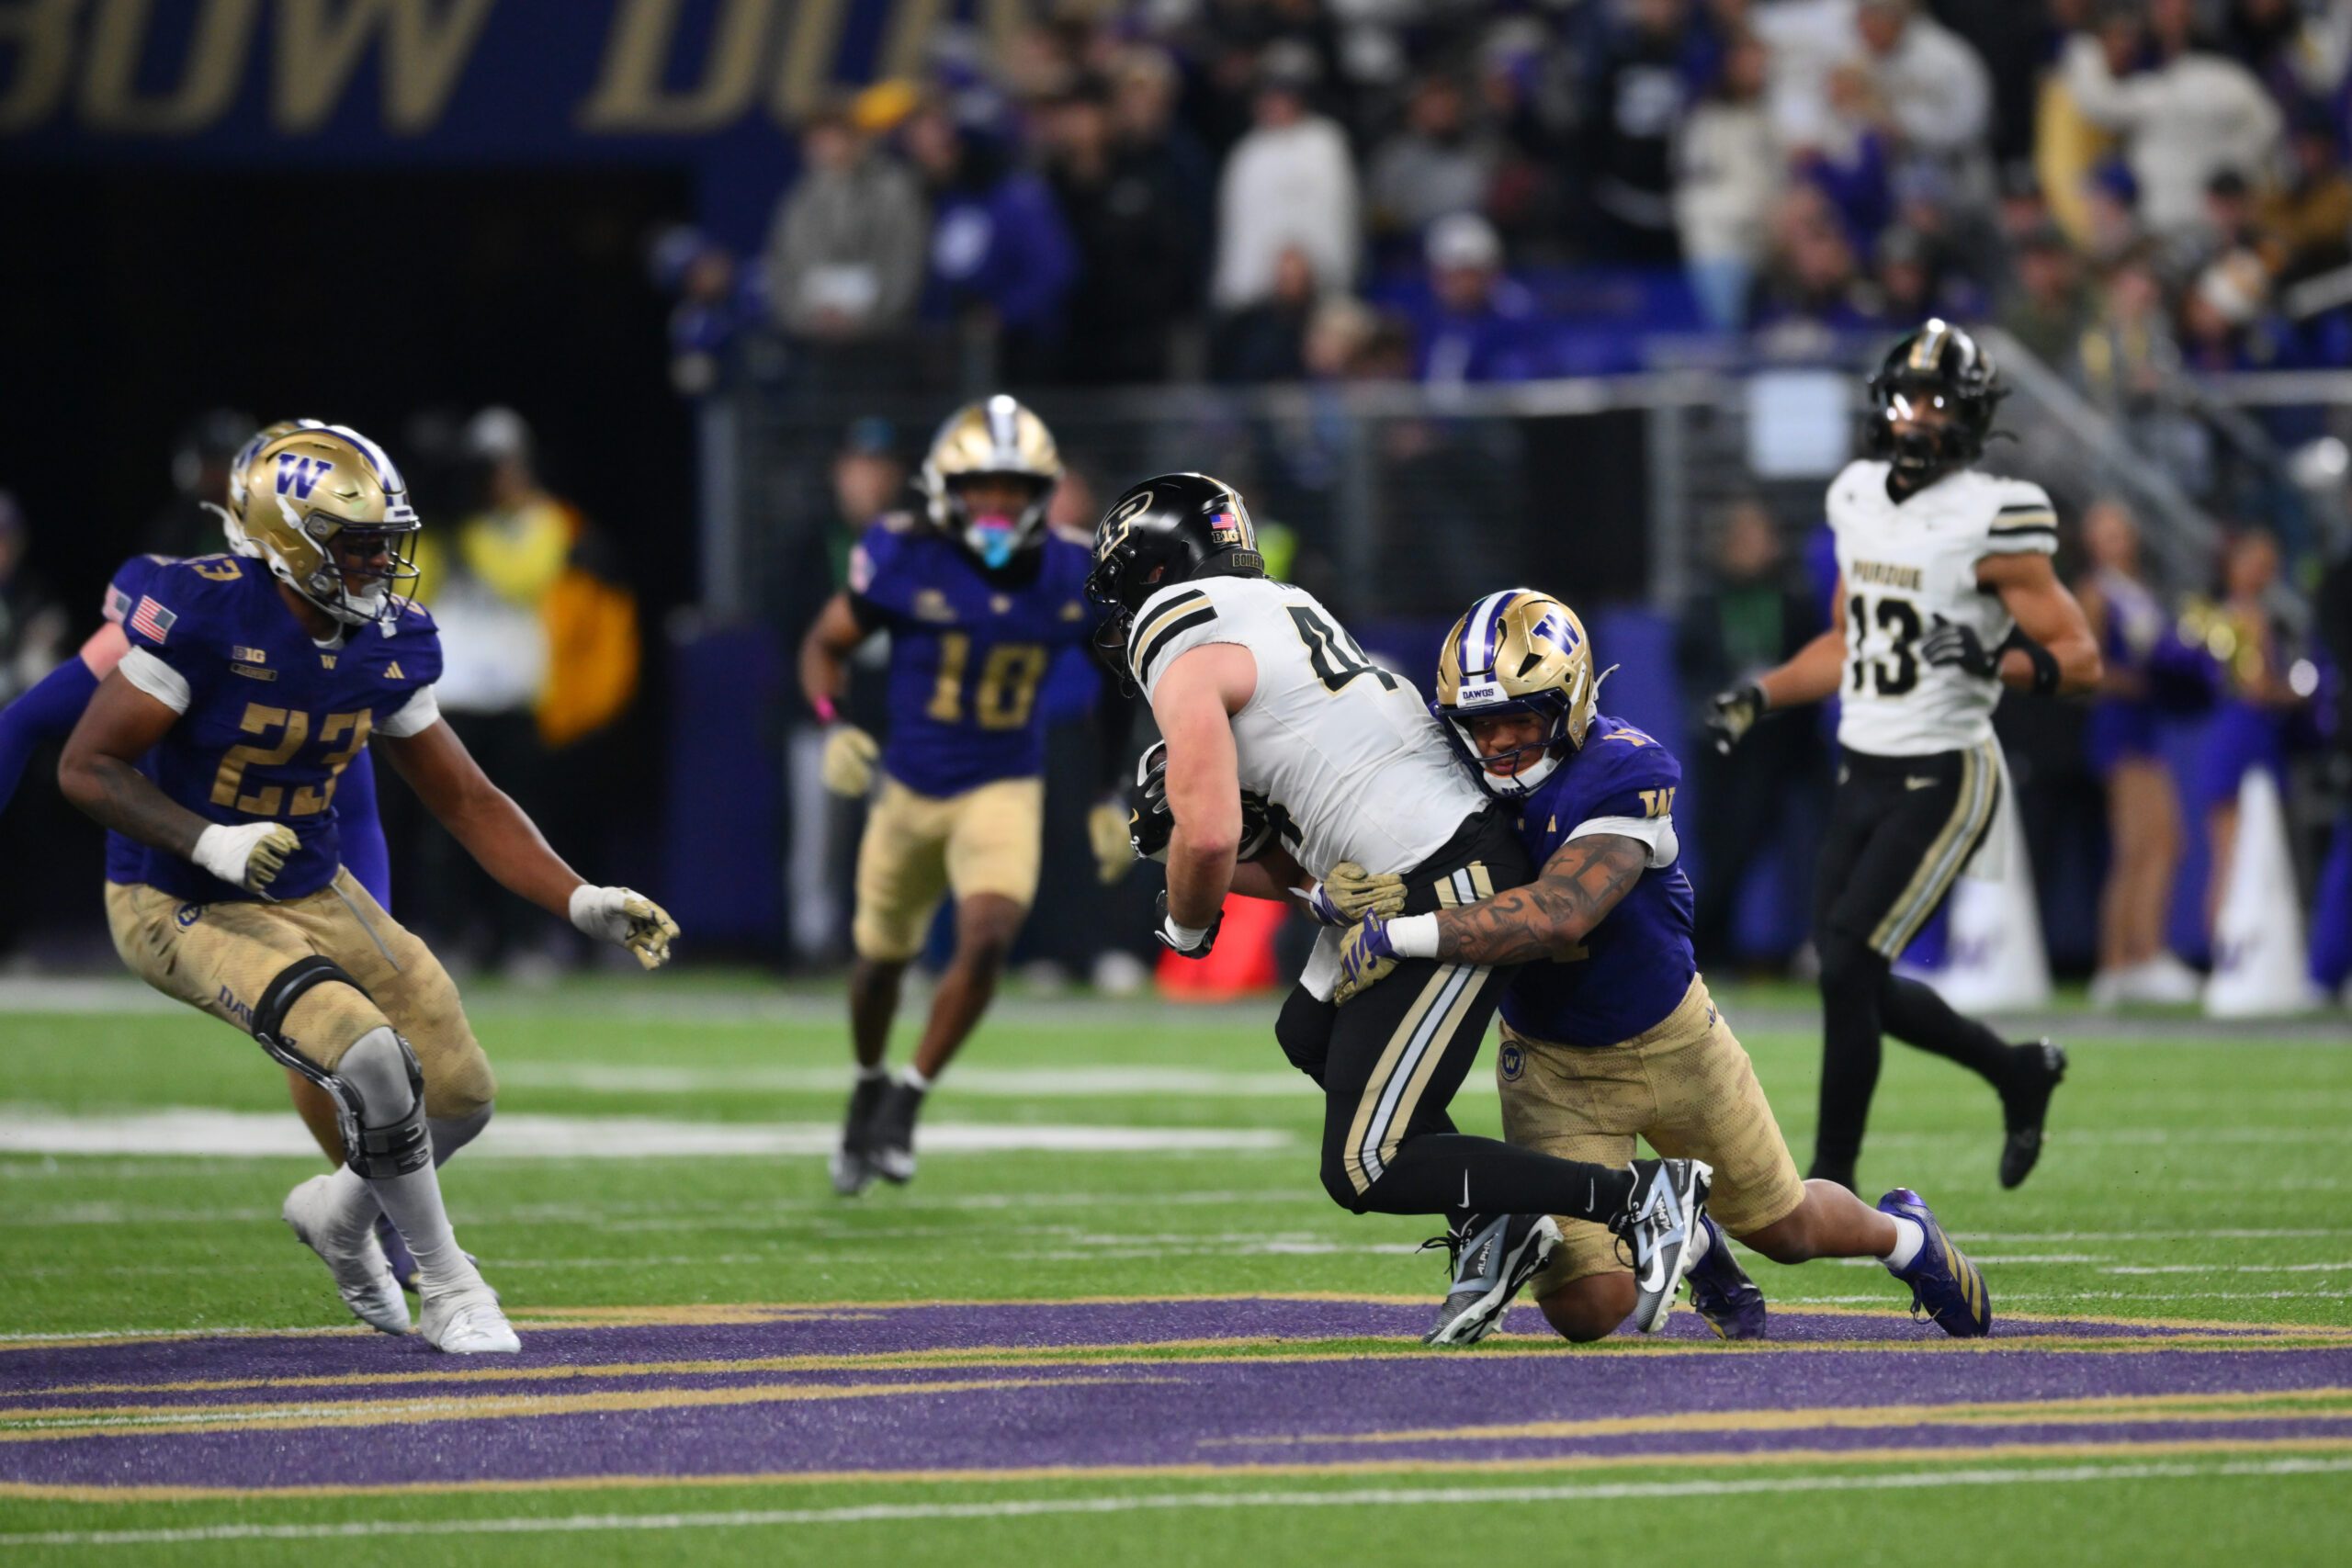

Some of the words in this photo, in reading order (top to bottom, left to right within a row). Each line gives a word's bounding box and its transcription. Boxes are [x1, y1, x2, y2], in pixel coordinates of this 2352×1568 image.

[277, 453, 334, 501] W
[1852, 560, 1922, 591] PURDUE
[1531, 610, 1581, 656] W
[1849, 593, 1922, 698] 13
[320, 655, 337, 670] W
[927, 632, 1046, 730] 10
[1462, 688, 1494, 699] DAWGS
[209, 702, 373, 817] 23
[1638, 786, 1676, 818] W
[1655, 1195, 1672, 1230] ALPHA
[1476, 1237, 1494, 1276] ALPHA
